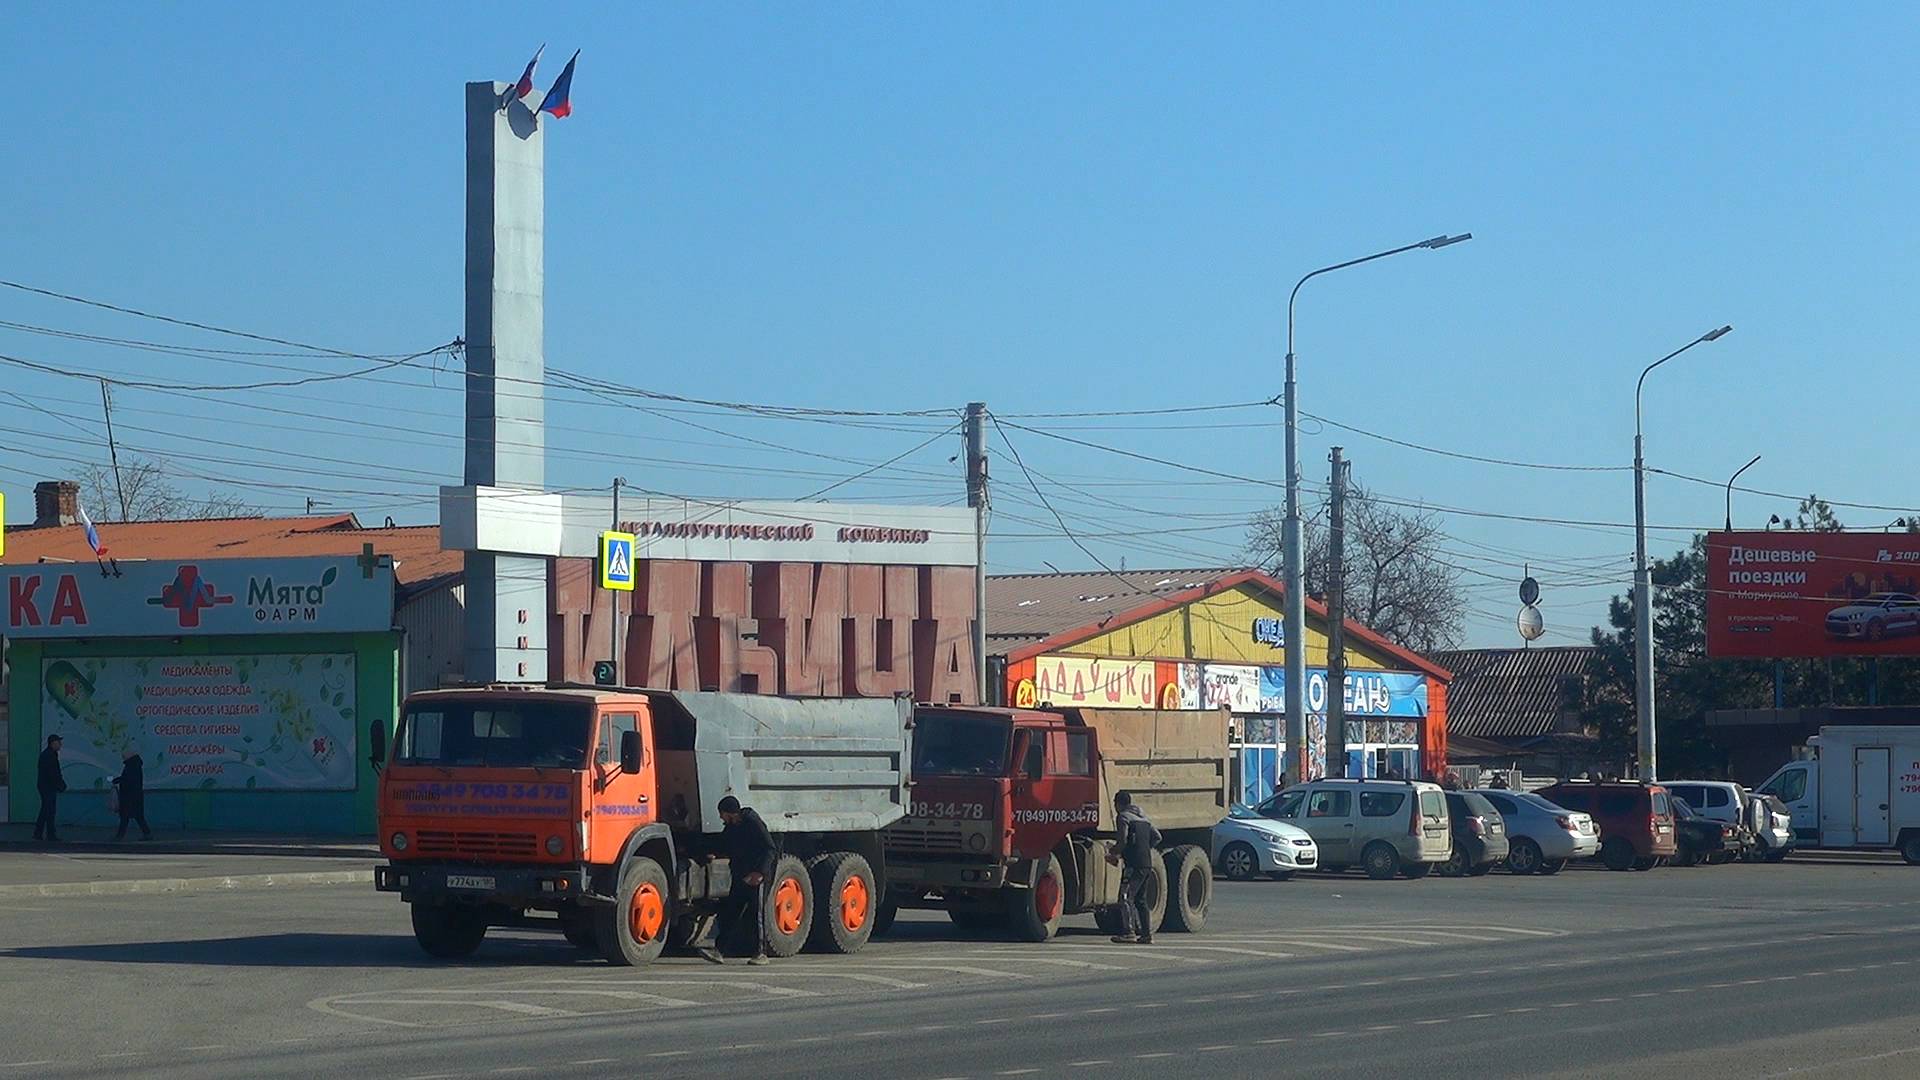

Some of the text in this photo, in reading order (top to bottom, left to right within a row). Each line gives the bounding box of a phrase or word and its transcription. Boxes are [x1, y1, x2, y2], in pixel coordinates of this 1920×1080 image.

[618, 521, 931, 543] МЕТАЛЛУРГИЧЕСКИЙ КОМБИНАТ
[1728, 546, 1816, 565] Дешевые
[1729, 571, 1806, 585] поездки
[248, 577, 324, 605] Мята
[255, 608, 316, 621] ФАРМ
[556, 558, 978, 705] ИЛЬИЧА
[1256, 618, 1284, 643] ОКЕА
[161, 666, 233, 677] МЕДИКАМЕНТЫ
[143, 685, 252, 697] МЕДИЦИНСКАЯ ОДЕЖДА
[1040, 661, 1151, 704] ЛАДУШКИ
[1020, 688, 1033, 706] 24
[1308, 673, 1391, 714] ОЕАН
[135, 704, 260, 716] ОРТОПЕДИЧЕСКИЕ ИЗДЕЛИЯ
[154, 724, 241, 736] СРЕДСТВА ГИГИЕНЫ
[170, 764, 224, 776] КОСМЕТИКА
[909, 801, 985, 820] 08-34-78
[1011, 808, 1098, 823] +7(949)708-34-78
